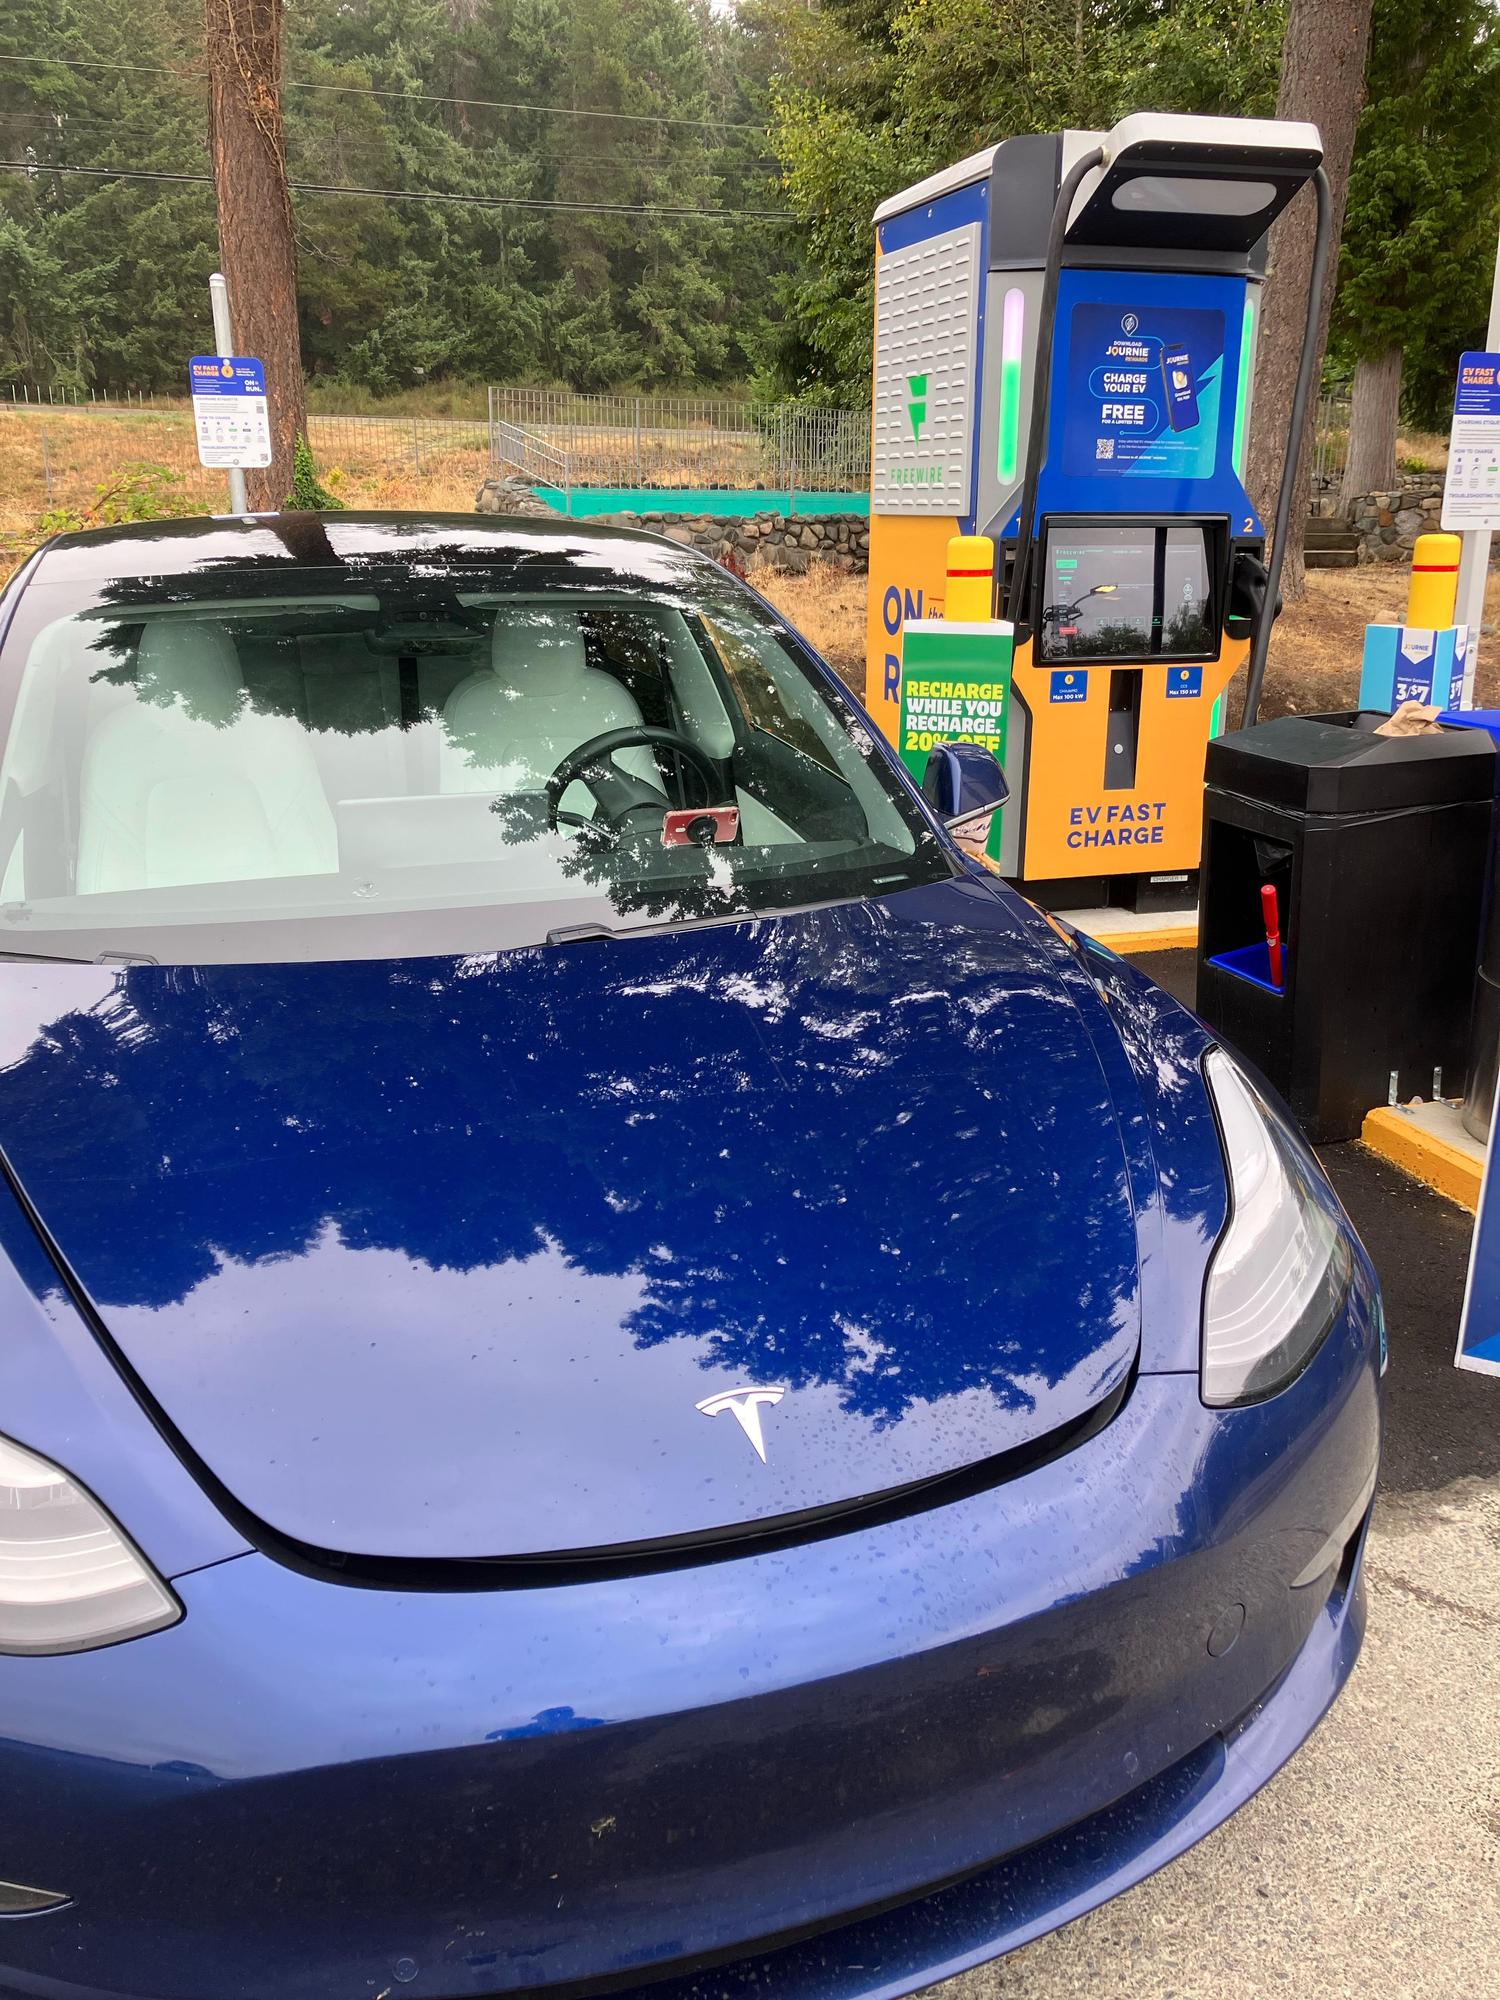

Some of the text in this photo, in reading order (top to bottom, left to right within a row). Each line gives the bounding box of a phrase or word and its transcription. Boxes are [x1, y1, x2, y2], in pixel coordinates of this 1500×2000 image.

[1106, 345, 1149, 356] JOURNIE
[1103, 373, 1147, 383] CHARGE
[1475, 368, 1495, 376] FAST
[1104, 383, 1146, 393] YOUR EV
[1102, 404, 1145, 419] FREE
[890, 466, 943, 484] FREEWIRE
[1243, 518, 1253, 532] 2
[906, 680, 1004, 700] RECHARGE
[906, 698, 1002, 717] WHILE YOU
[906, 714, 1001, 735] RECHARGE.
[1070, 802, 1166, 825] EV FAST
[1067, 826, 1164, 848] CHARGE
